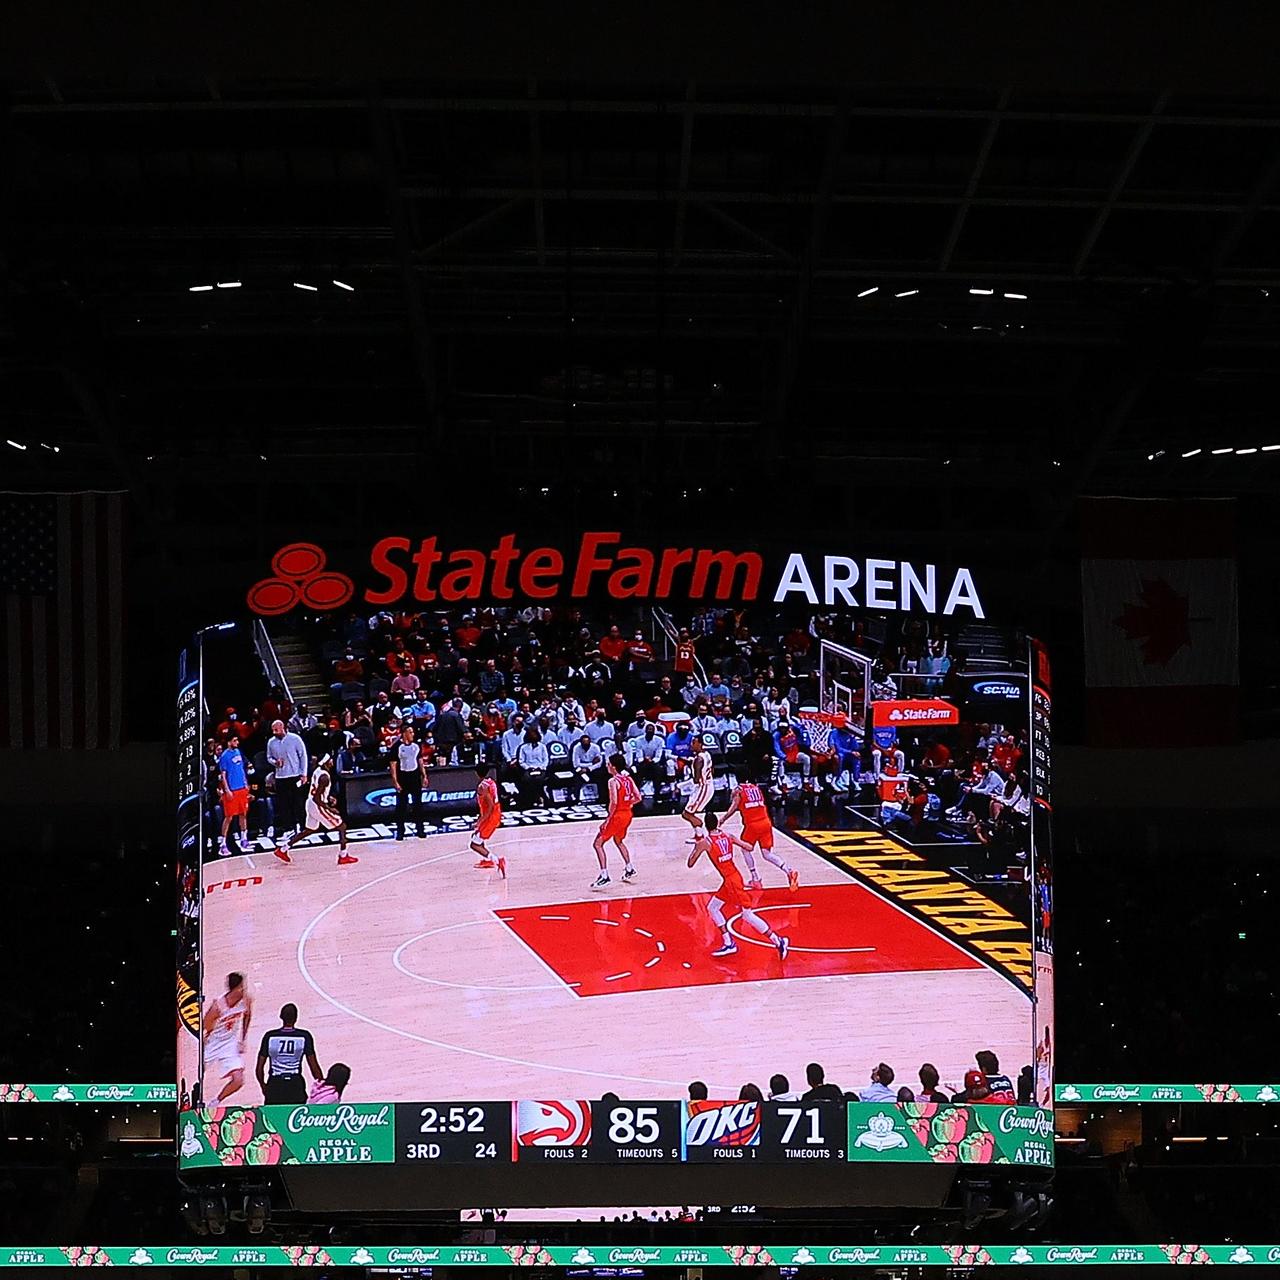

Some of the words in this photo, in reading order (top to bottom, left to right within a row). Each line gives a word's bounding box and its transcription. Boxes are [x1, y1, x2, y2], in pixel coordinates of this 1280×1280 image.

[773, 552, 985, 619] ARENA
[278, 1040, 295, 1055] 70
[419, 1107, 486, 1133] 2:52
[607, 1107, 660, 1145] 85
[686, 1101, 758, 1146] OKC
[776, 1107, 825, 1145] 71
[318, 1138, 357, 1147] REGAL
[305, 1146, 372, 1162] APPLE
[406, 1144, 441, 1159] 3RD
[474, 1143, 497, 1158] 24
[544, 1149, 575, 1159] FOULS
[581, 1149, 588, 1159] 2
[616, 1149, 664, 1159] TIMEOUTS
[671, 1149, 679, 1159] 5
[713, 1149, 744, 1158] FOULS
[750, 1149, 757, 1158] 1
[784, 1149, 831, 1159] TIMEOUTS
[837, 1149, 845, 1159] 3
[1015, 1148, 1051, 1165] APPLE
[233, 1251, 266, 1263] APPLE
[675, 1250, 708, 1262] APPLE
[1111, 1249, 1144, 1261] APPLE
